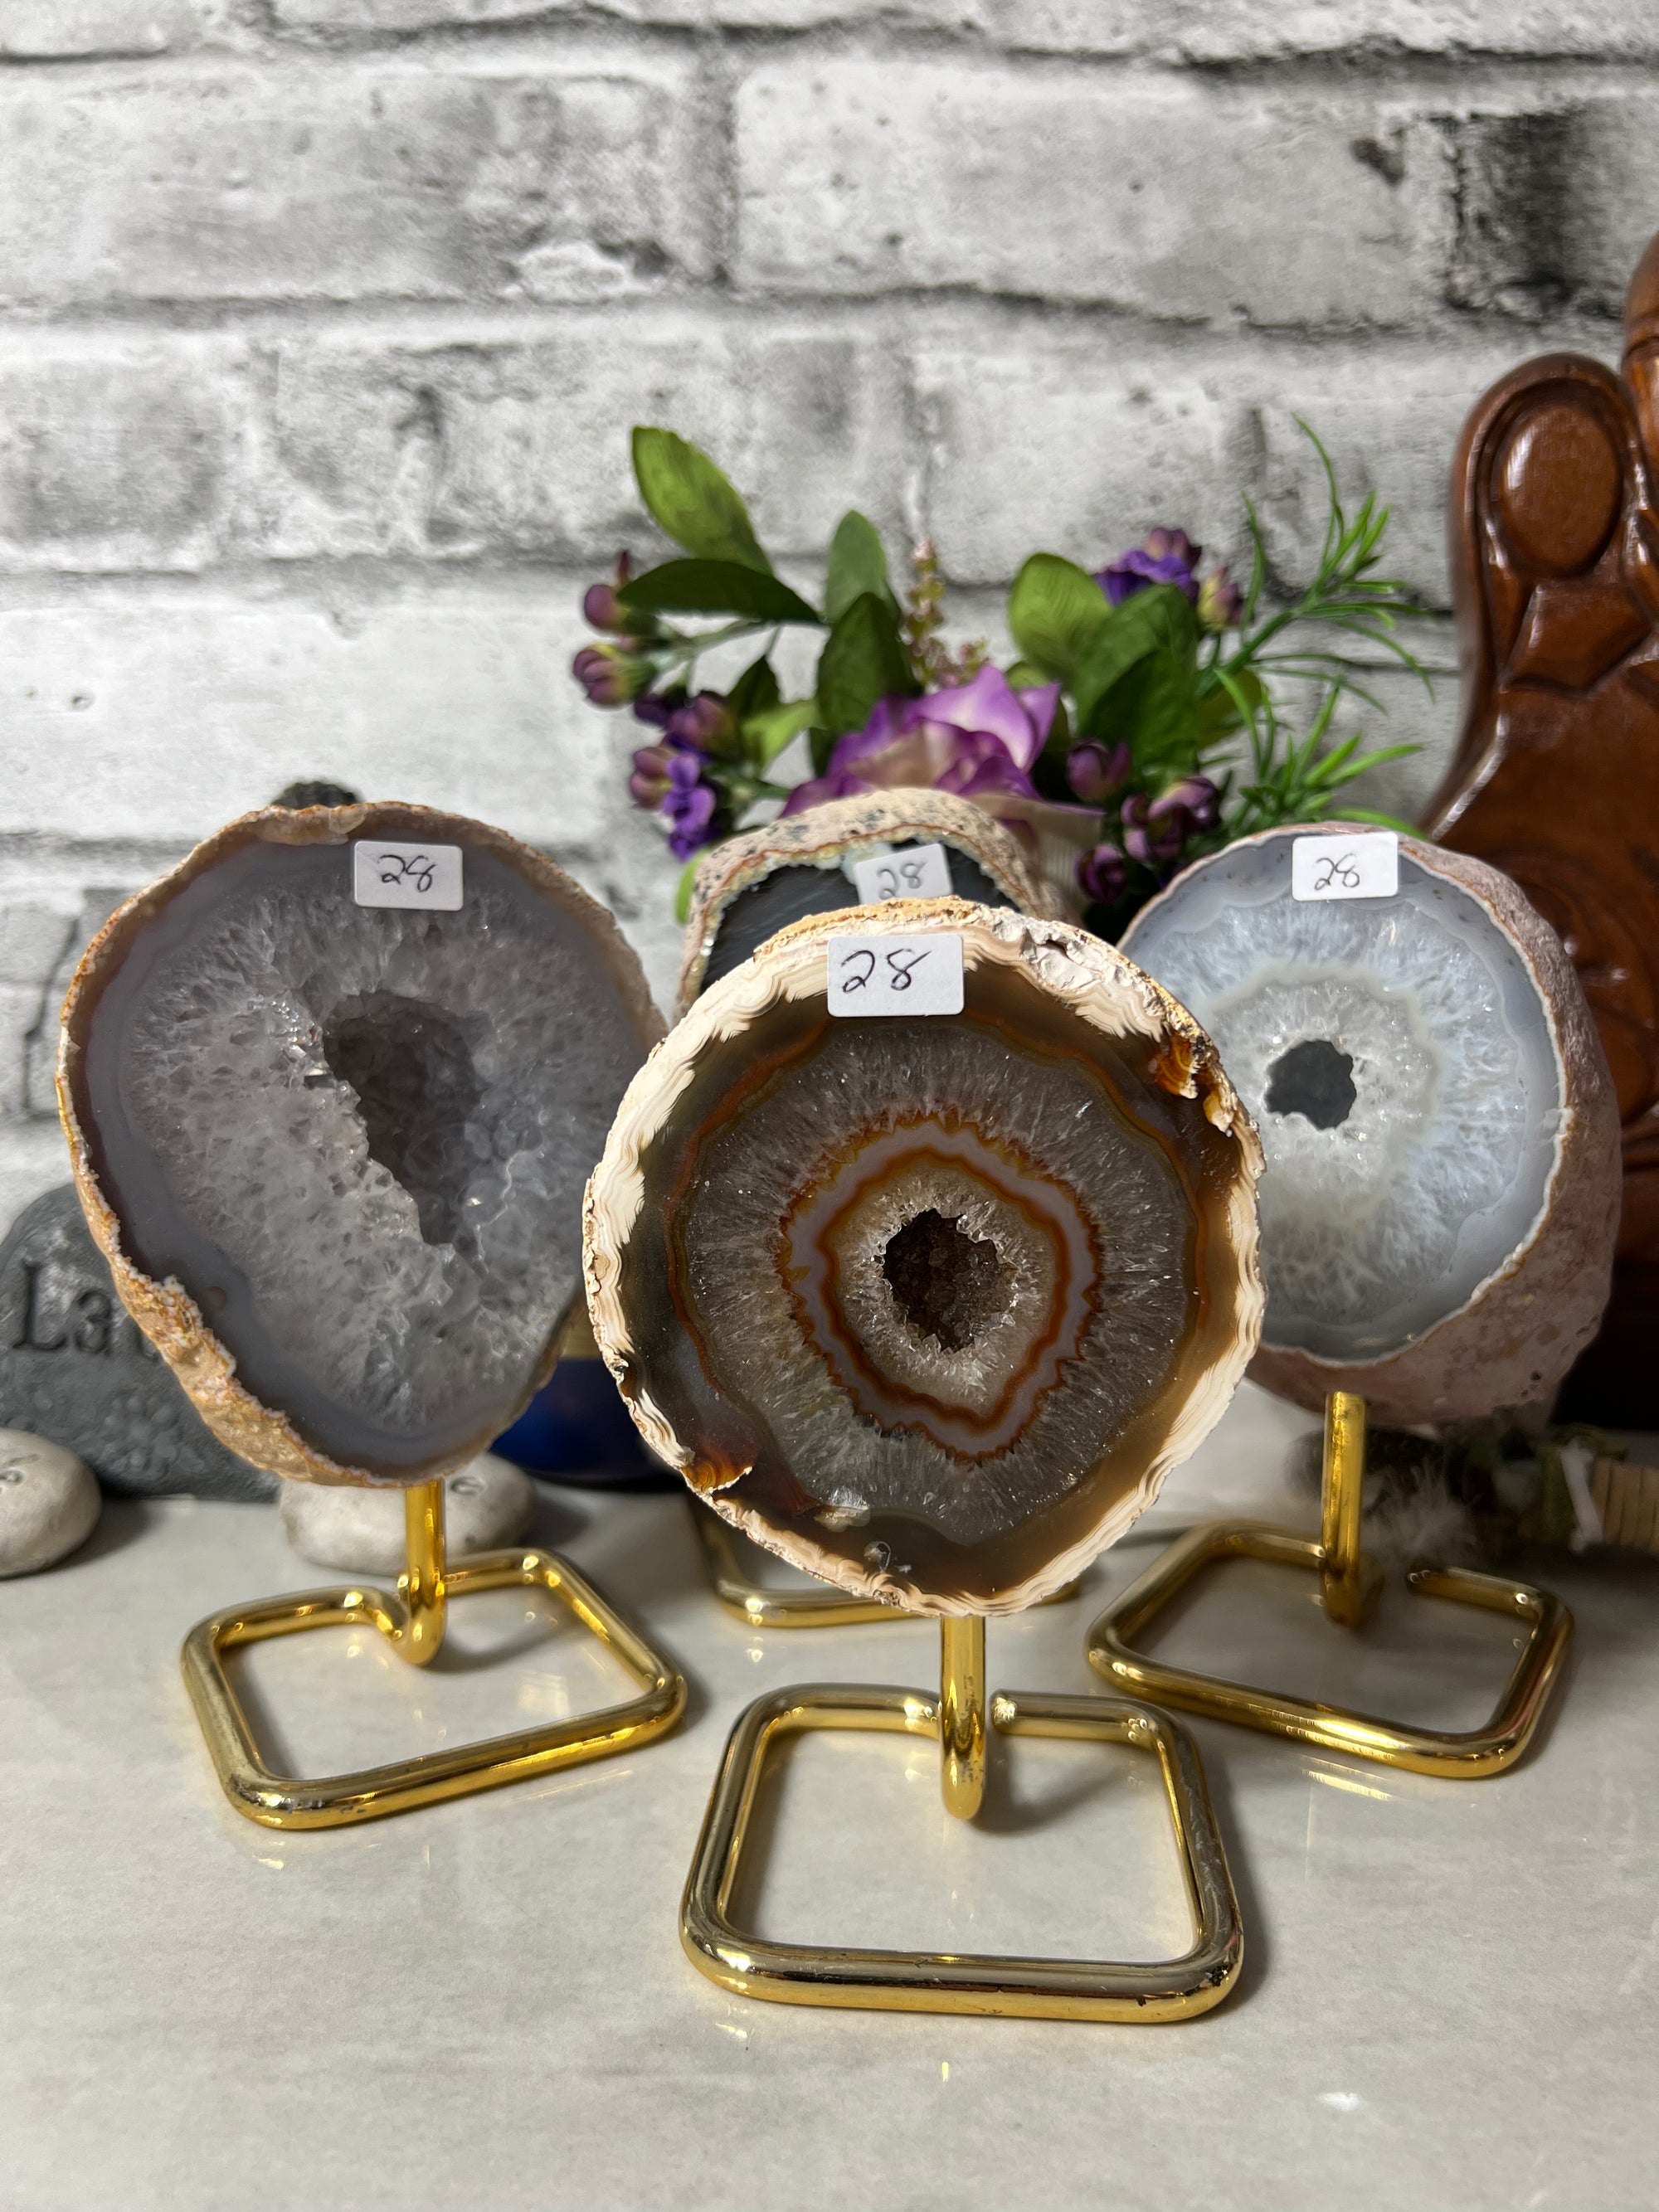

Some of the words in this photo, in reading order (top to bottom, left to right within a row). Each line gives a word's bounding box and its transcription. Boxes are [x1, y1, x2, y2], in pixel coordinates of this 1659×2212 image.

[377, 853, 438, 893] 28
[876, 860, 928, 901] 28
[1313, 853, 1360, 891] 28
[840, 948, 932, 994] 28
